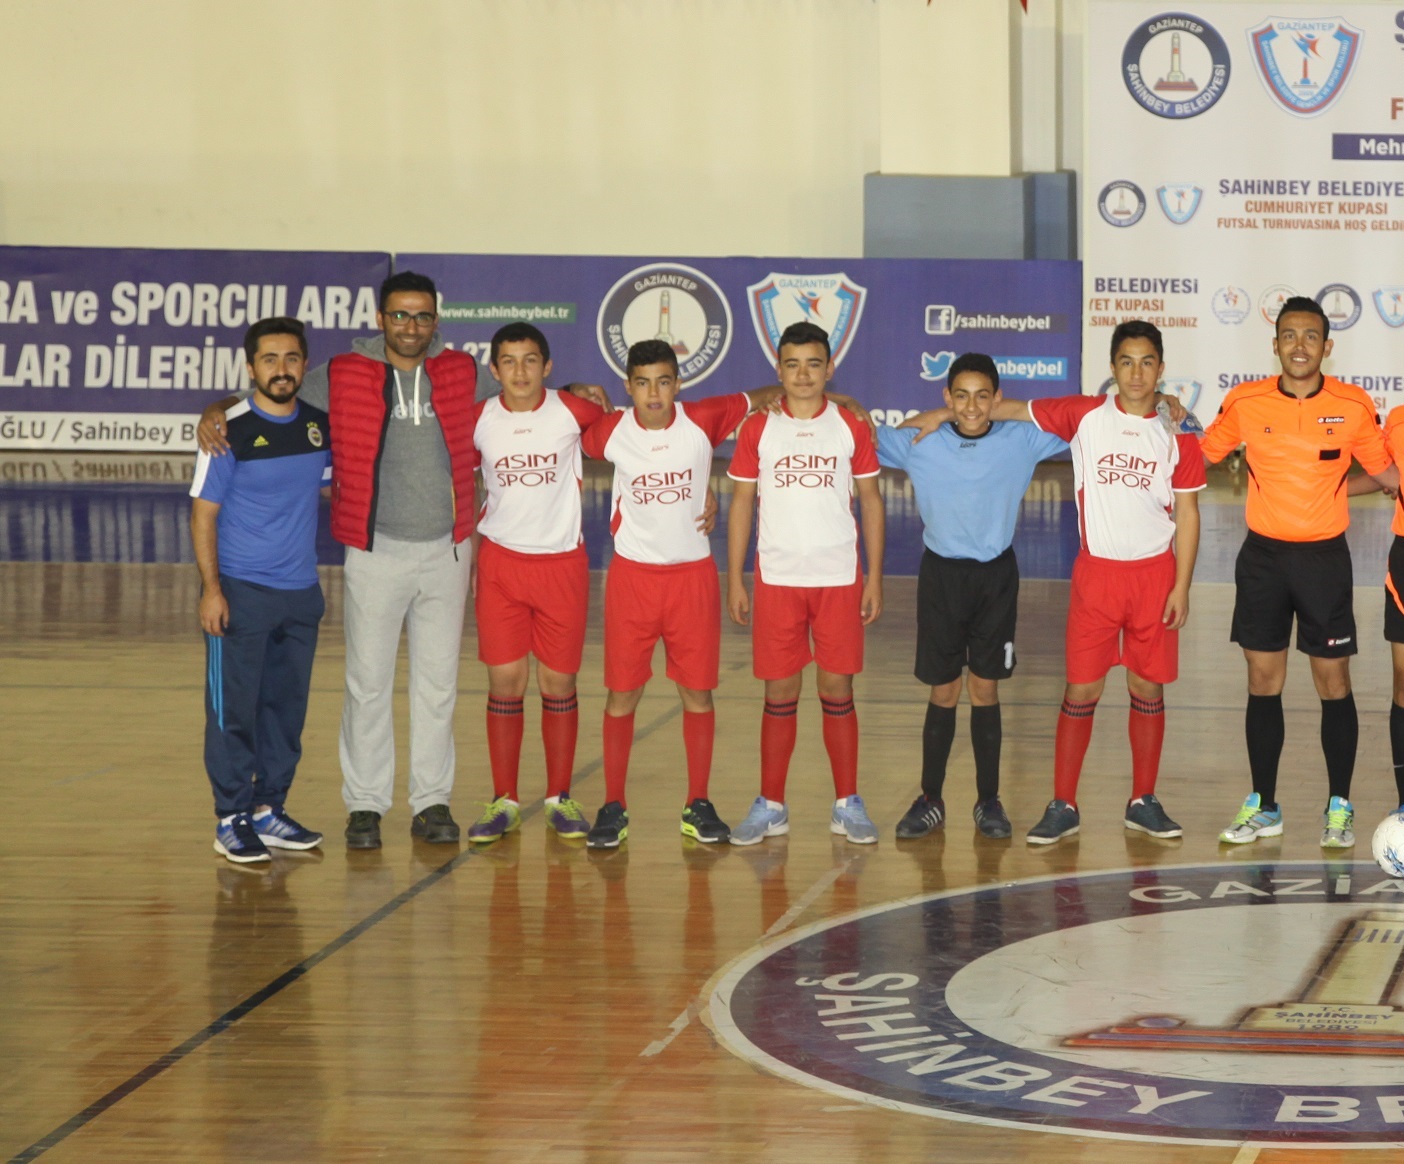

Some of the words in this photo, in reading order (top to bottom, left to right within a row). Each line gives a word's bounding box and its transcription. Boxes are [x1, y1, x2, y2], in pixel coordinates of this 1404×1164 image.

[1338, 201, 1388, 215] KUPASI
[1217, 217, 1259, 230] FUTSAL
[1263, 217, 1341, 231] TURNUVASINA
[51, 290, 99, 325] ve
[1115, 298, 1164, 311] KUPASI
[84, 334, 250, 390] DİLERİM
[71, 421, 173, 444] Şahinbey
[495, 452, 557, 469] ASIM
[774, 455, 837, 469] ASIM
[1097, 453, 1158, 475] ASIM
[497, 471, 557, 487] SPOR
[631, 469, 692, 486] ASIM
[774, 474, 835, 488] SPOR
[1097, 470, 1151, 491] SPOR
[632, 487, 692, 505] SPOR
[1004, 641, 1014, 669] 1
[795, 971, 1212, 1116] ŞAHİNBEY
